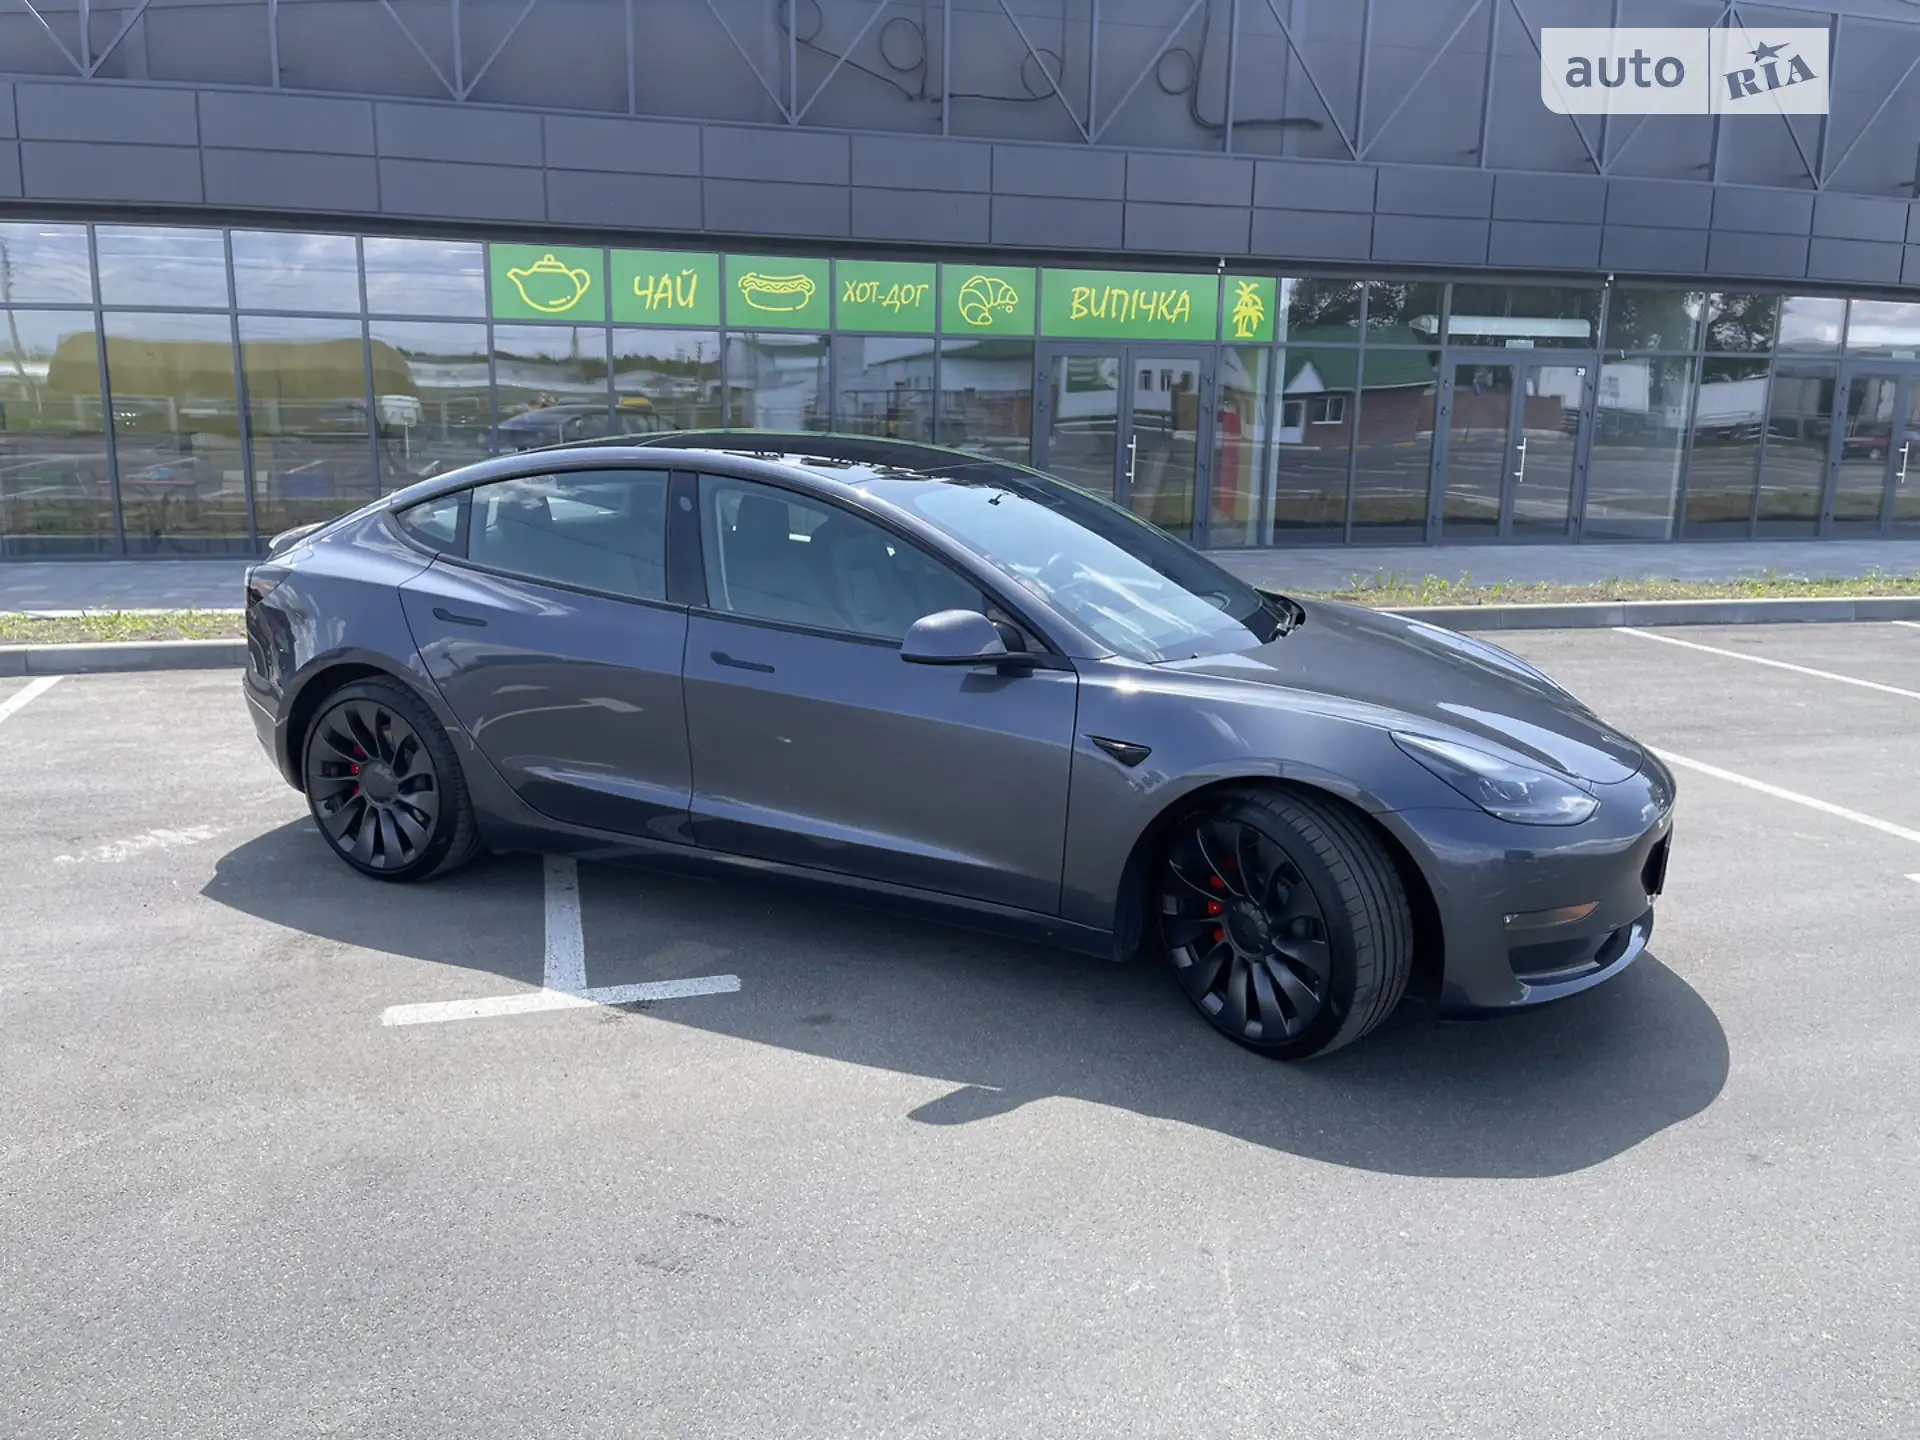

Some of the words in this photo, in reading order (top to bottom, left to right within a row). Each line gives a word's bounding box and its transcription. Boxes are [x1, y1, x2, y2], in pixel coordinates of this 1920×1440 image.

[633, 269, 697, 309] ЧАЙ
[842, 280, 929, 313] ХОТ-ДОГ
[1070, 285, 1191, 323] ВИПІЧКА
